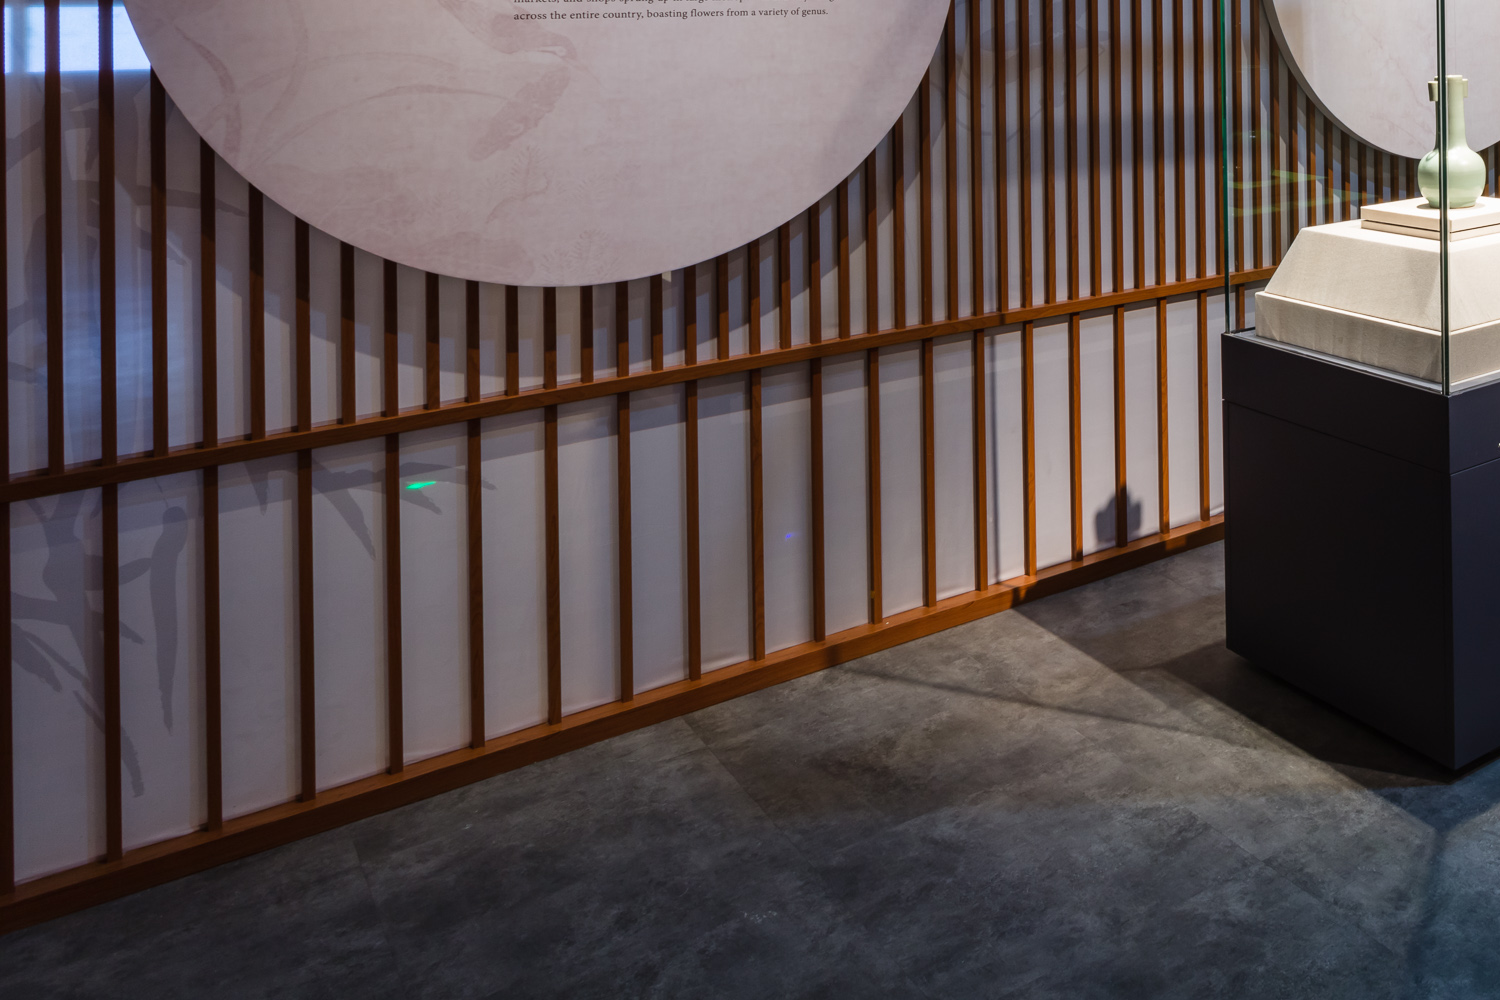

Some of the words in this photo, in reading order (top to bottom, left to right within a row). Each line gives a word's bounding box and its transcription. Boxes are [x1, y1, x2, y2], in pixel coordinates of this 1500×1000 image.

[514, 12, 547, 21] across
[551, 11, 566, 19] the
[570, 11, 600, 19] entire
[603, 11, 644, 21] country,
[647, 10, 688, 19] boasting
[690, 9, 724, 17] flowers
[726, 8, 748, 17] from
[759, 8, 788, 17] variety
[791, 7, 800, 15] of
[802, 8, 828, 17] genus.
